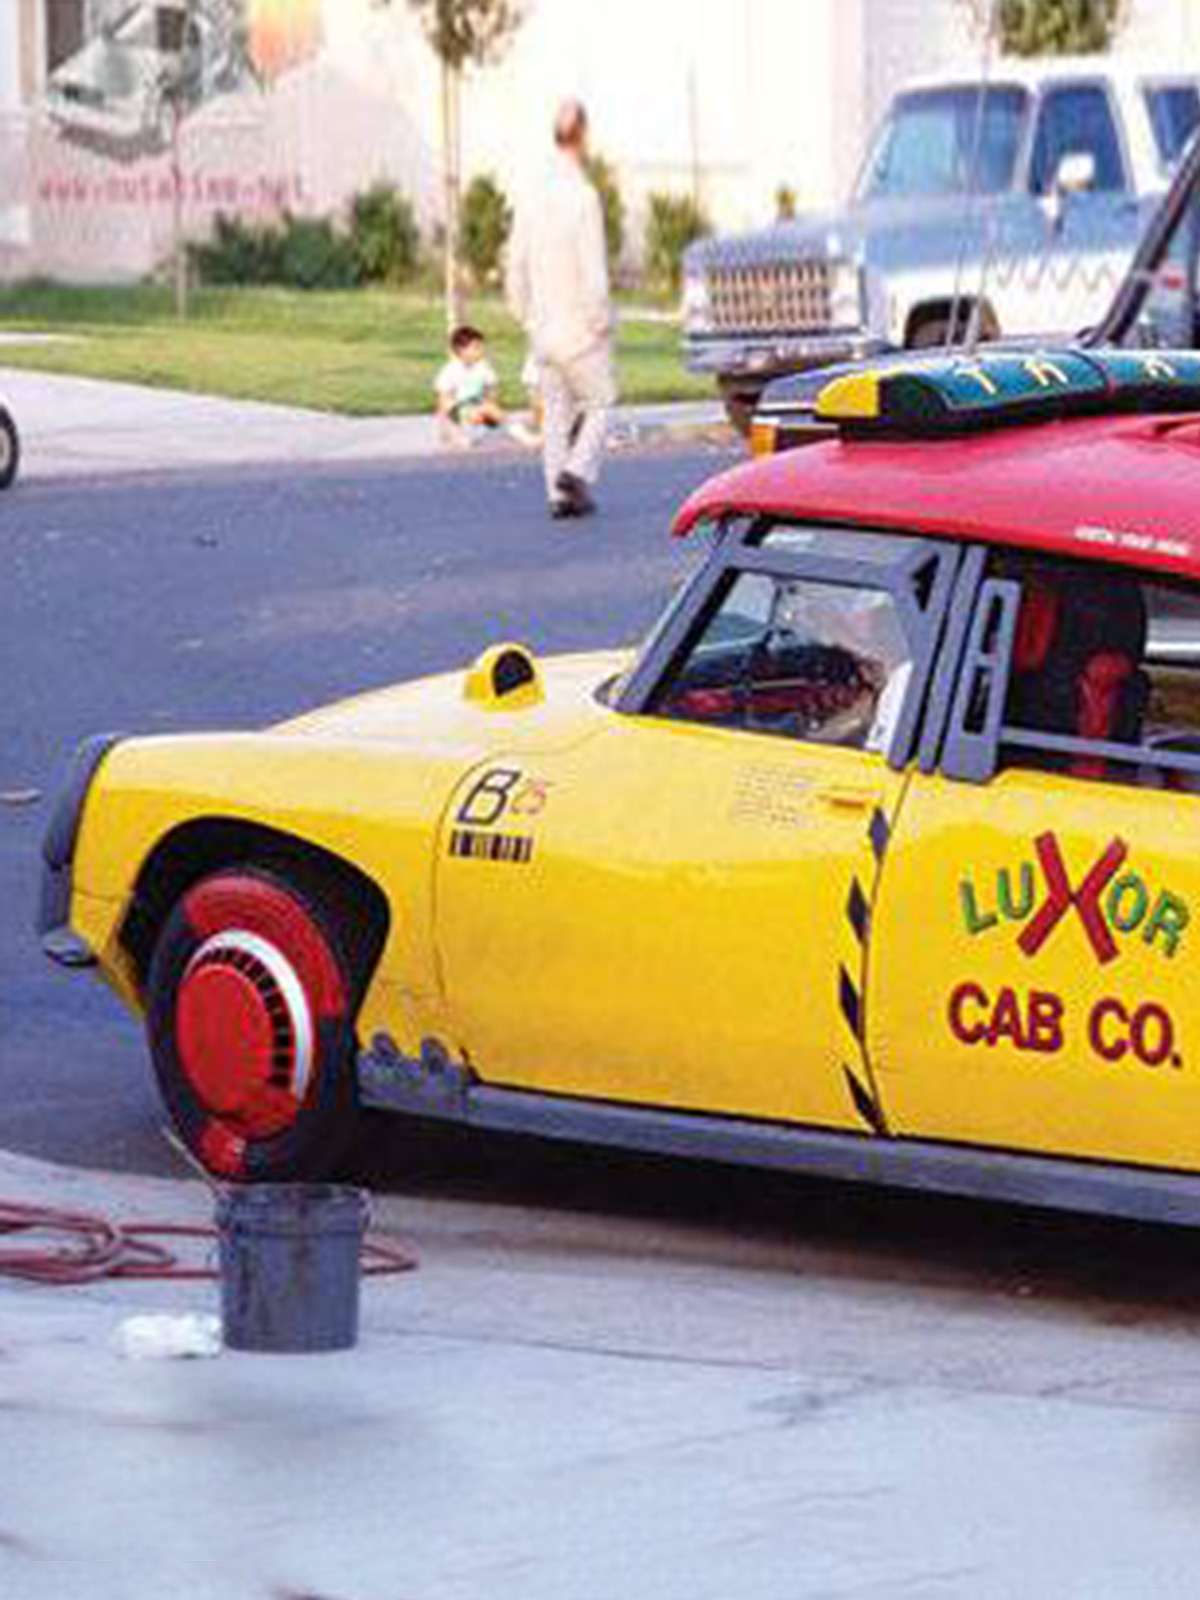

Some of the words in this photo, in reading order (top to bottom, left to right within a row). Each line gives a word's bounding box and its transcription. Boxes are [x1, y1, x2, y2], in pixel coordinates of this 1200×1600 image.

[959, 830, 1191, 965] LUXOR
[947, 982, 1064, 1053] CAB
[1088, 996, 1182, 1069] CO.
